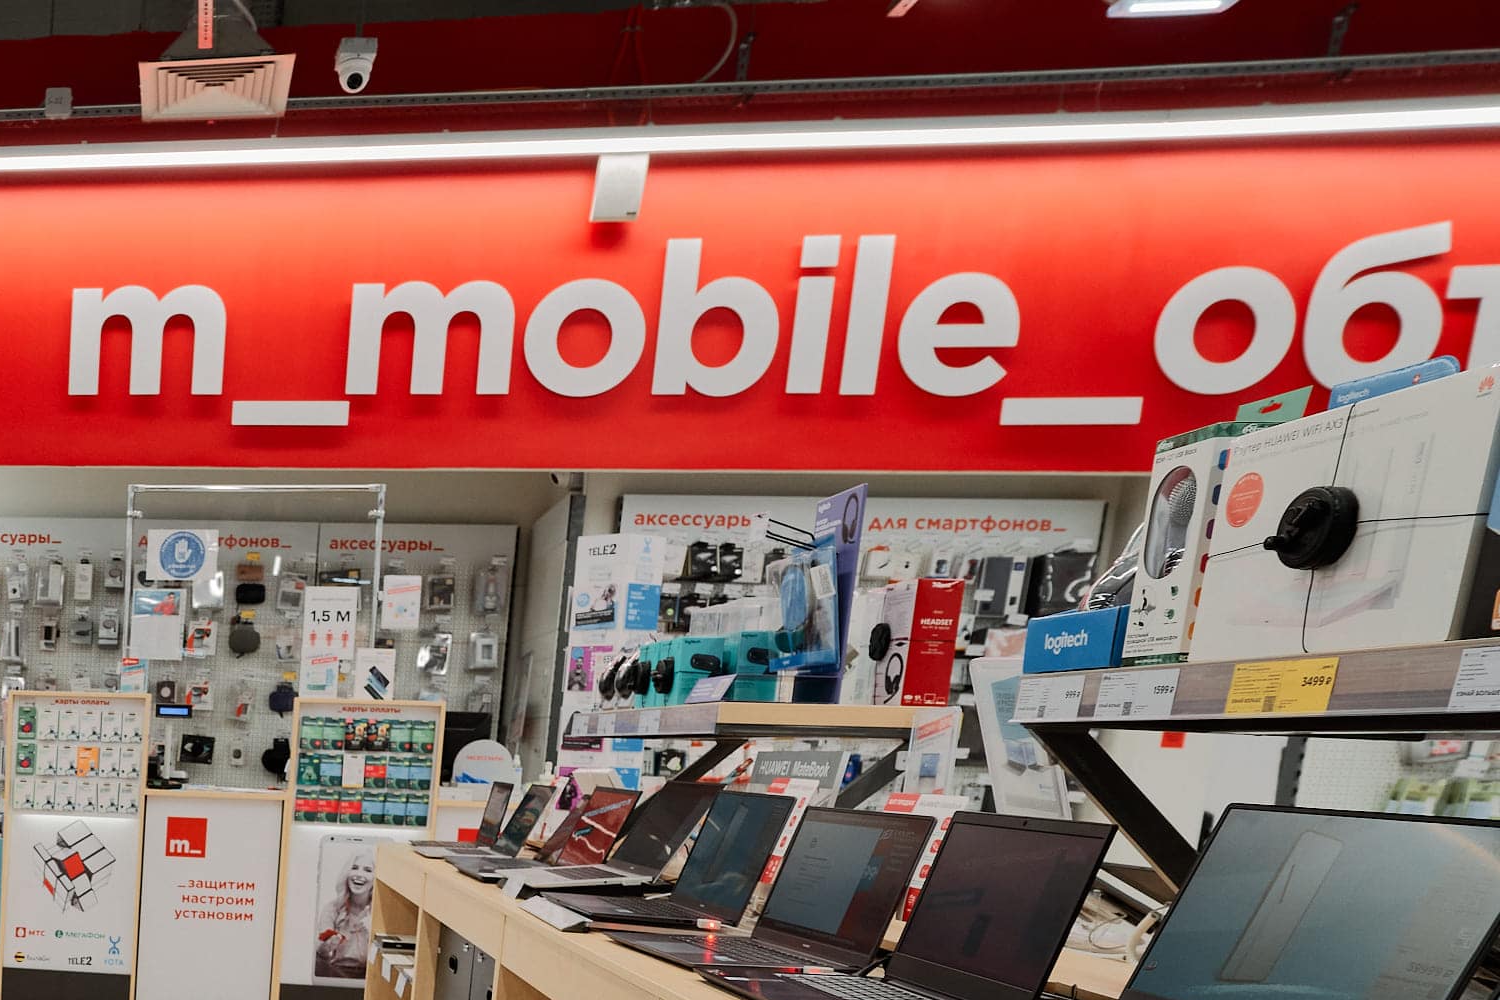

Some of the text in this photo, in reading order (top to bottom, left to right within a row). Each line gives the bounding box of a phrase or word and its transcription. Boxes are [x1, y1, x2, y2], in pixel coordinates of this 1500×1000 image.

[1264, 430, 1300, 447] HUAWEI
[868, 516, 908, 534] для
[588, 543, 618, 557] TELE2
[310, 611, 331, 624] 1,5
[920, 618, 954, 626] HEADSET
[1044, 629, 1089, 655] logitech
[1301, 675, 1325, 687] 3499
[1153, 684, 1170, 695] 1599
[758, 758, 831, 778] HUAWEI MateBook
[182, 894, 255, 906] настроим
[174, 909, 254, 922] установим
[68, 956, 93, 966] TELE2
